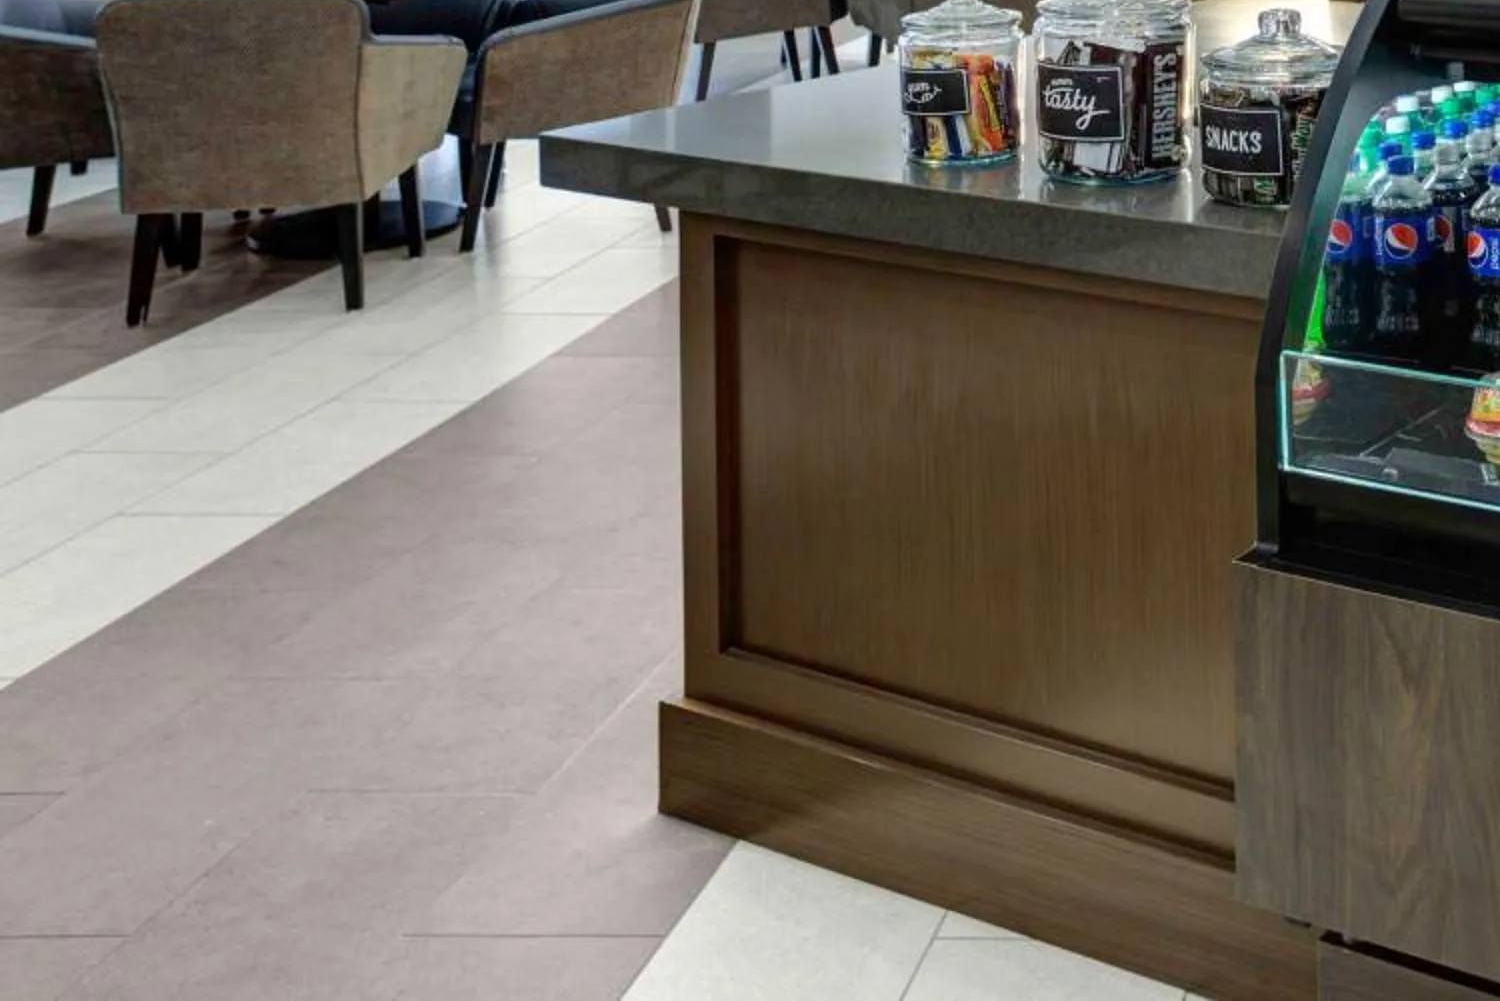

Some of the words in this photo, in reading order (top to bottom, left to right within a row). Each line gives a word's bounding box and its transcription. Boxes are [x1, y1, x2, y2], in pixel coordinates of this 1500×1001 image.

[1043, 84, 1111, 130] tasty
[1152, 52, 1178, 159] HERSHEY'S
[1205, 123, 1263, 155] SNACKS
